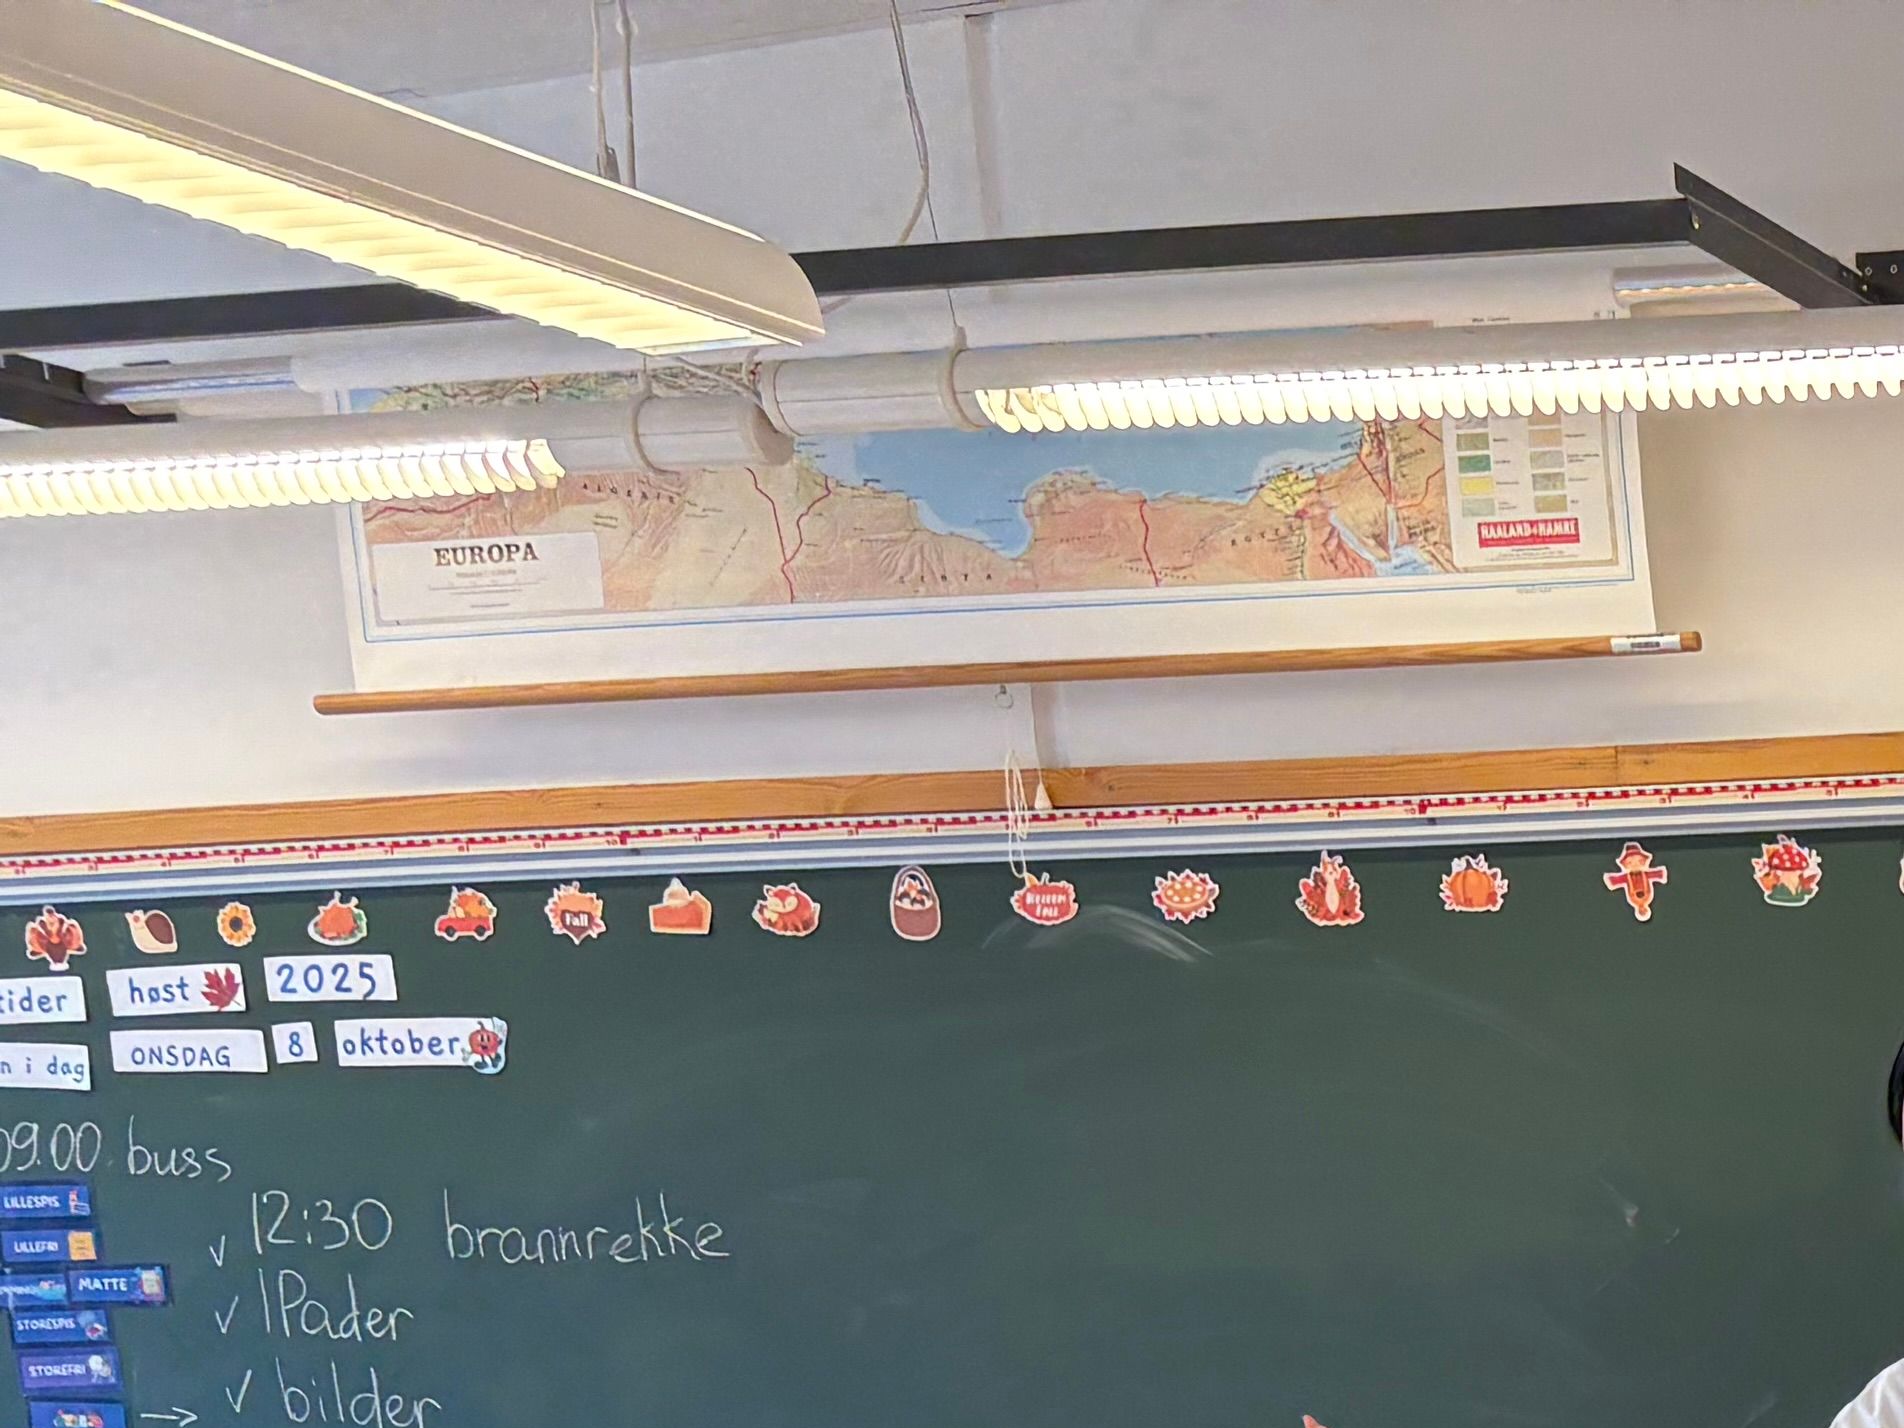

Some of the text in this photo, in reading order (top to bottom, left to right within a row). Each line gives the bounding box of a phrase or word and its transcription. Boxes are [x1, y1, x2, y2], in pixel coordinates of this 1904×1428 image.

[434, 540, 540, 568] EUROPA
[565, 912, 589, 928] Fall
[128, 975, 190, 1005] høst
[276, 961, 378, 999] 2025
[131, 1044, 232, 1070] ONSDAG
[287, 1032, 303, 1058] 8
[342, 1027, 460, 1058] oktober
[47, 1053, 86, 1085] dag
[126, 1113, 234, 1181] buss
[251, 1187, 731, 1263] 12:30 brannrekke
[78, 1277, 129, 1292] MATTE
